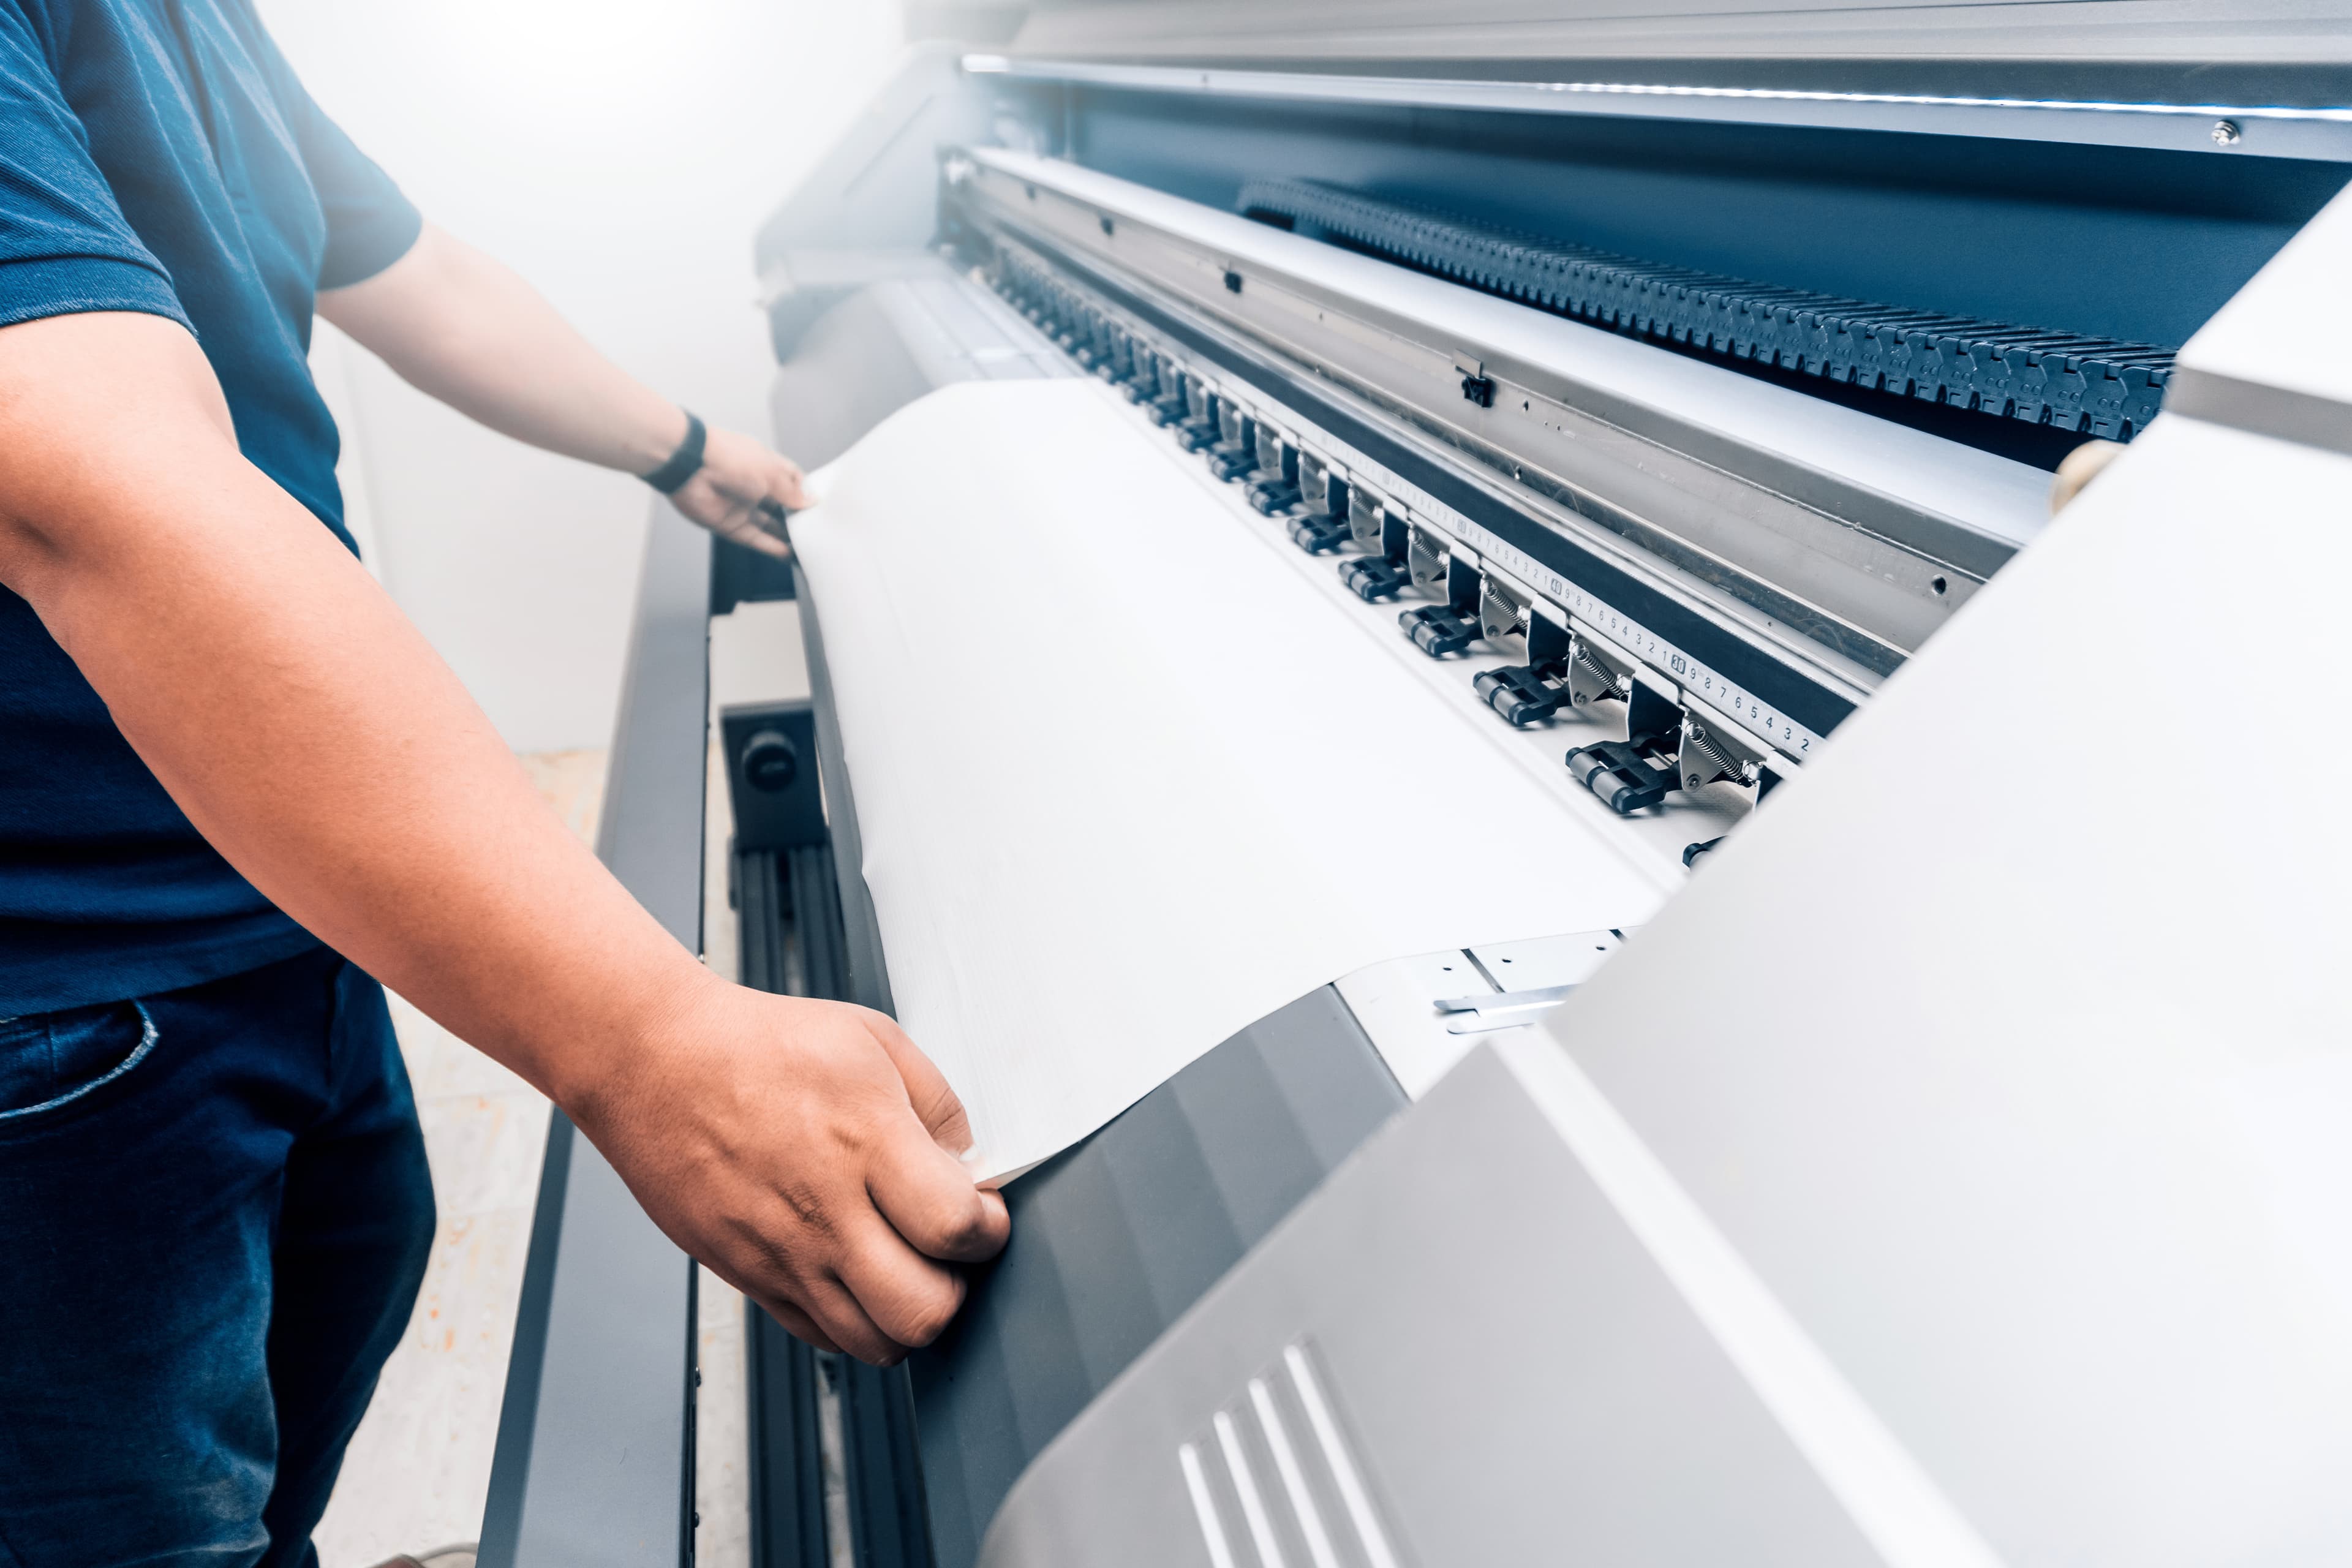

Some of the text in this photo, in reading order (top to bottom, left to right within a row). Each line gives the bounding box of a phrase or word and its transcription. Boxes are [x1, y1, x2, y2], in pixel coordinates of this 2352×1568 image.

[1495, 544, 1499, 554] 6
[1504, 550, 1509, 560] 5
[1513, 556, 1518, 565] 4
[1524, 562, 1529, 572] 3
[1533, 568, 1539, 579] 2
[1544, 575, 1548, 586] 1
[1551, 578, 1561, 595] 40
[1565, 588, 1570, 599] 9
[1576, 595, 1581, 606] 8
[1588, 602, 1593, 612] 7
[1599, 610, 1604, 621] 6
[1611, 617, 1616, 628] 5
[1623, 625, 1628, 636] 4
[1636, 633, 1642, 645] 3
[1648, 642, 1655, 654] 2
[1663, 650, 1667, 662] 1
[1672, 655, 1685, 674] 30
[1690, 668, 1696, 680] 9
[1705, 677, 1711, 689] 8
[1721, 686, 1727, 698] 7
[1735, 696, 1741, 709] 6
[1751, 706, 1758, 718] 5
[1765, 717, 1773, 729] 4
[1784, 727, 1792, 740] 3
[1801, 738, 1809, 752] 2
